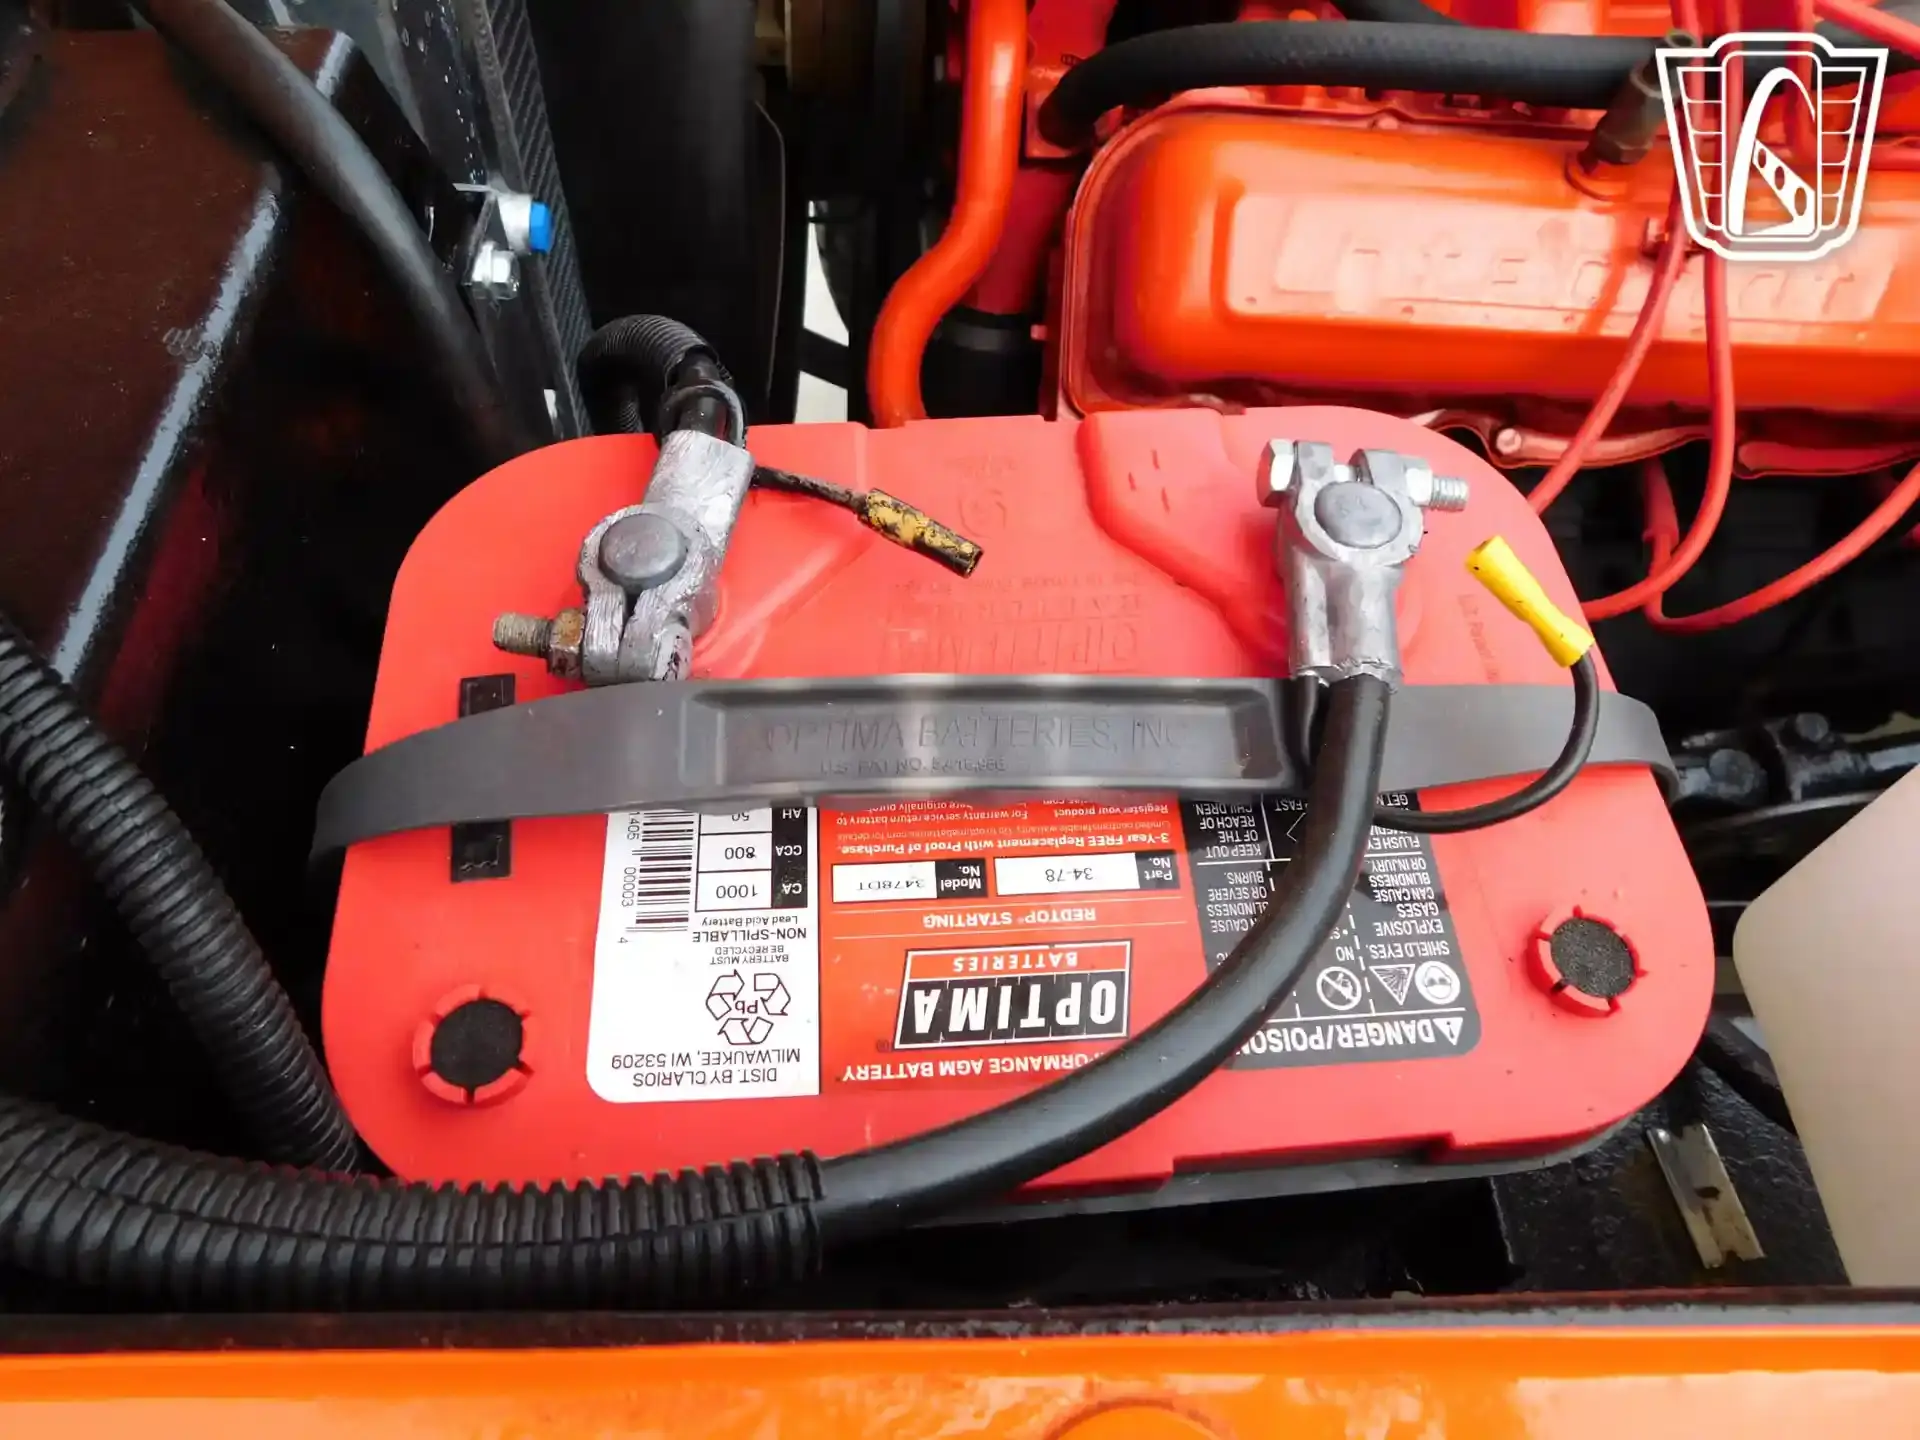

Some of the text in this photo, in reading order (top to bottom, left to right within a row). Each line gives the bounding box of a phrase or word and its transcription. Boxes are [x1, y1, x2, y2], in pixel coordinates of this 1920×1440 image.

[1387, 793, 1409, 806] GET
[782, 808, 802, 819] AH
[1053, 807, 1096, 818] product
[1123, 802, 1168, 815] Register
[836, 810, 1028, 826] For warranty service return battery to
[1200, 815, 1256, 830] REACH OF
[837, 832, 1169, 856] 3-Year FREE Replacement with Proof of Purchase.
[1217, 830, 1258, 843] OF THE
[1366, 835, 1420, 850] FLUSH EY
[724, 846, 755, 860] 800
[775, 844, 802, 856] CCA
[1205, 842, 1262, 858] KEEP OUT
[1148, 856, 1170, 868] No.
[1409, 858, 1426, 871] OR
[958, 866, 980, 877] No.
[1044, 867, 1094, 882] 34-78
[1143, 870, 1172, 881] Part
[1223, 870, 1264, 885] BURNS.
[621, 866, 636, 908] 00003
[856, 878, 926, 891] 3478DT
[940, 878, 982, 891] Model
[1368, 872, 1431, 888] BLINDNESS
[715, 884, 758, 899] 1000
[782, 882, 802, 894] CA
[1207, 886, 1268, 900] OR SEVERE
[1372, 886, 1434, 902] CAN CAUSE
[1396, 902, 1439, 918] GASES
[701, 915, 798, 928] Lead Acid Battery
[922, 911, 1012, 929] STARTING
[1210, 918, 1248, 933] CAUSE
[1372, 918, 1444, 936] EXPLOSIVE
[692, 928, 807, 942] NON-SPILLABLE
[714, 944, 784, 956] BE RECYCLED
[1335, 945, 1354, 962] NO
[1365, 940, 1450, 960] SHIELD EYES.
[710, 954, 790, 966] BATTERY MUST
[952, 950, 1078, 972] BATTERIES
[734, 1000, 758, 1014] Pb
[912, 979, 1117, 1034] OPTIMA
[611, 1048, 801, 1070] MILWAUKEE, WI 53209
[842, 1052, 1098, 1082] ORMANCE AGM BATTERY
[632, 1067, 778, 1088] DIST. BY CLARIOS
